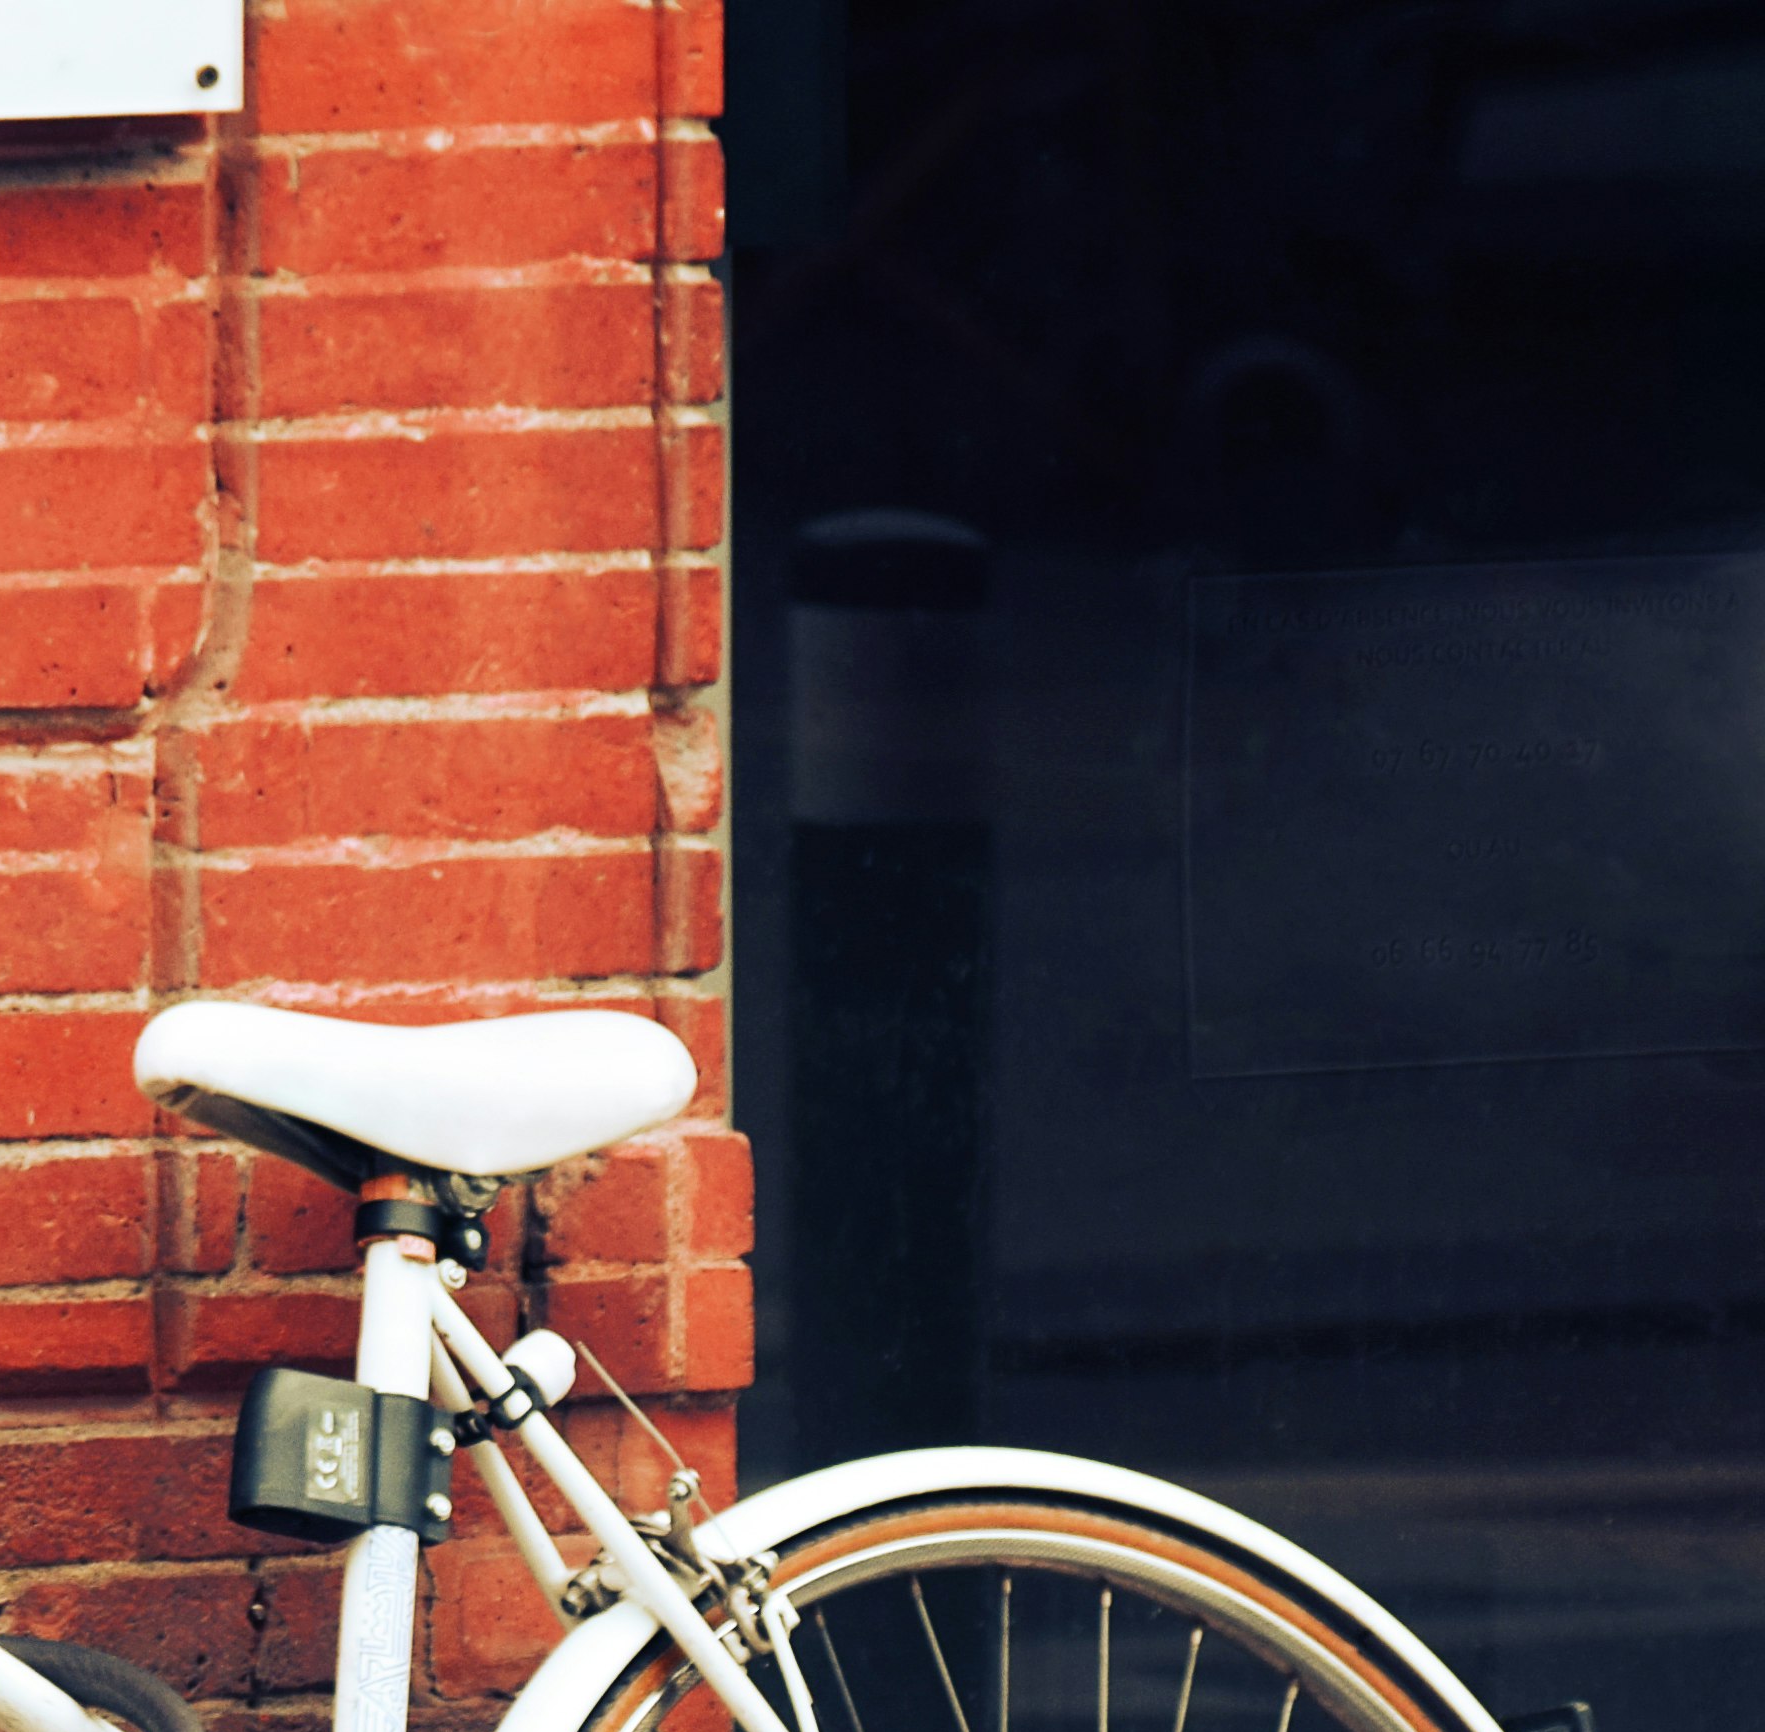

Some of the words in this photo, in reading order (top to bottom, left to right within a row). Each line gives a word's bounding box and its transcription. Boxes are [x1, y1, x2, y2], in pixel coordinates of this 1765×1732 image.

[1460, 600, 1528, 623] NOUS
[1535, 596, 1602, 619] VOUS
[1357, 643, 1425, 668] NOUS
[1371, 748, 1405, 776] 07
[1418, 739, 1453, 771] 67
[1467, 742, 1502, 770] 70
[1514, 739, 1551, 764] 40
[1445, 837, 1480, 862] OU
[1371, 938, 1405, 968] 06
[1420, 934, 1453, 962] 66
[1469, 939, 1502, 968] 94
[1517, 935, 1550, 962] 77
[1565, 927, 1598, 962] 85
